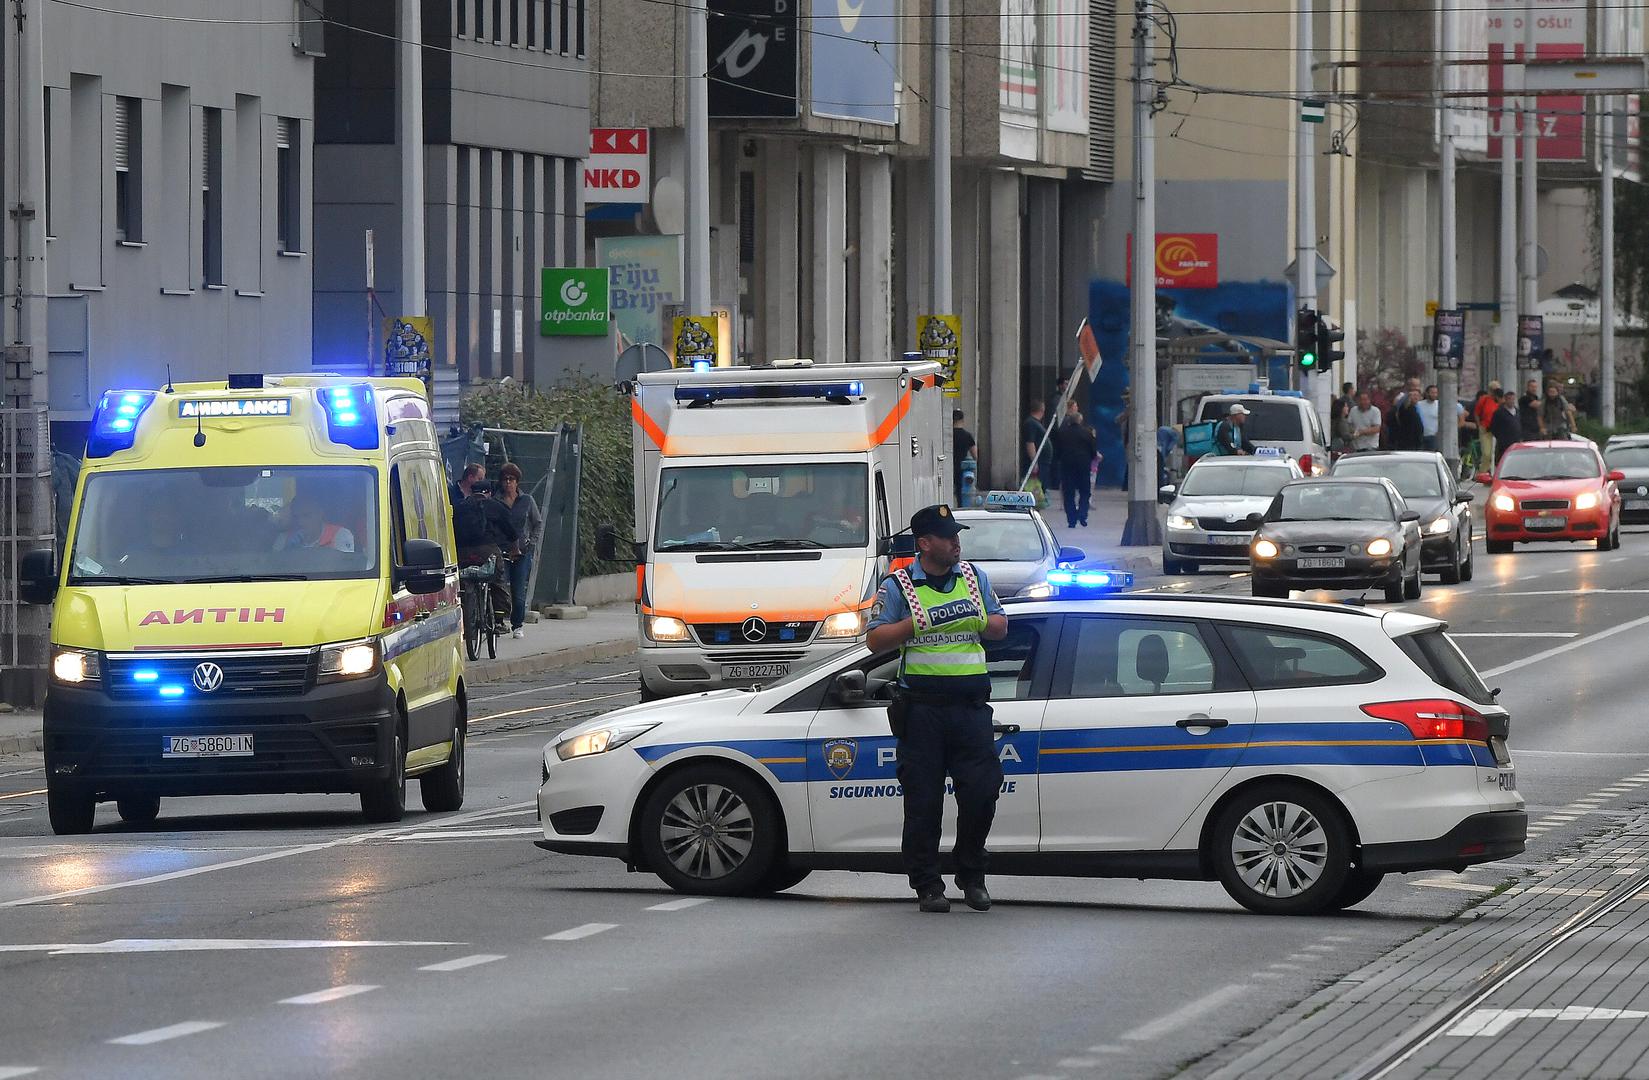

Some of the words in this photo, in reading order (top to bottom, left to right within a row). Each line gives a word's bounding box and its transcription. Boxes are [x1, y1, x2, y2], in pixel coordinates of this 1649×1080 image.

[1537, 16, 1572, 29] OŠLI!
[584, 168, 641, 189] NKD
[609, 263, 660, 290] Fiju
[544, 308, 605, 324] otpbanka
[181, 400, 288, 416] AMBULANCE
[991, 494, 1030, 503] TAXI
[930, 602, 978, 622] POLICIJA
[728, 665, 742, 677] ZG
[749, 664, 789, 677] 8227-BN
[172, 738, 190, 752] ZG
[198, 736, 253, 752] 5860-IN
[825, 740, 856, 748] POLICIJA
[829, 785, 904, 799] SIGURNOS
